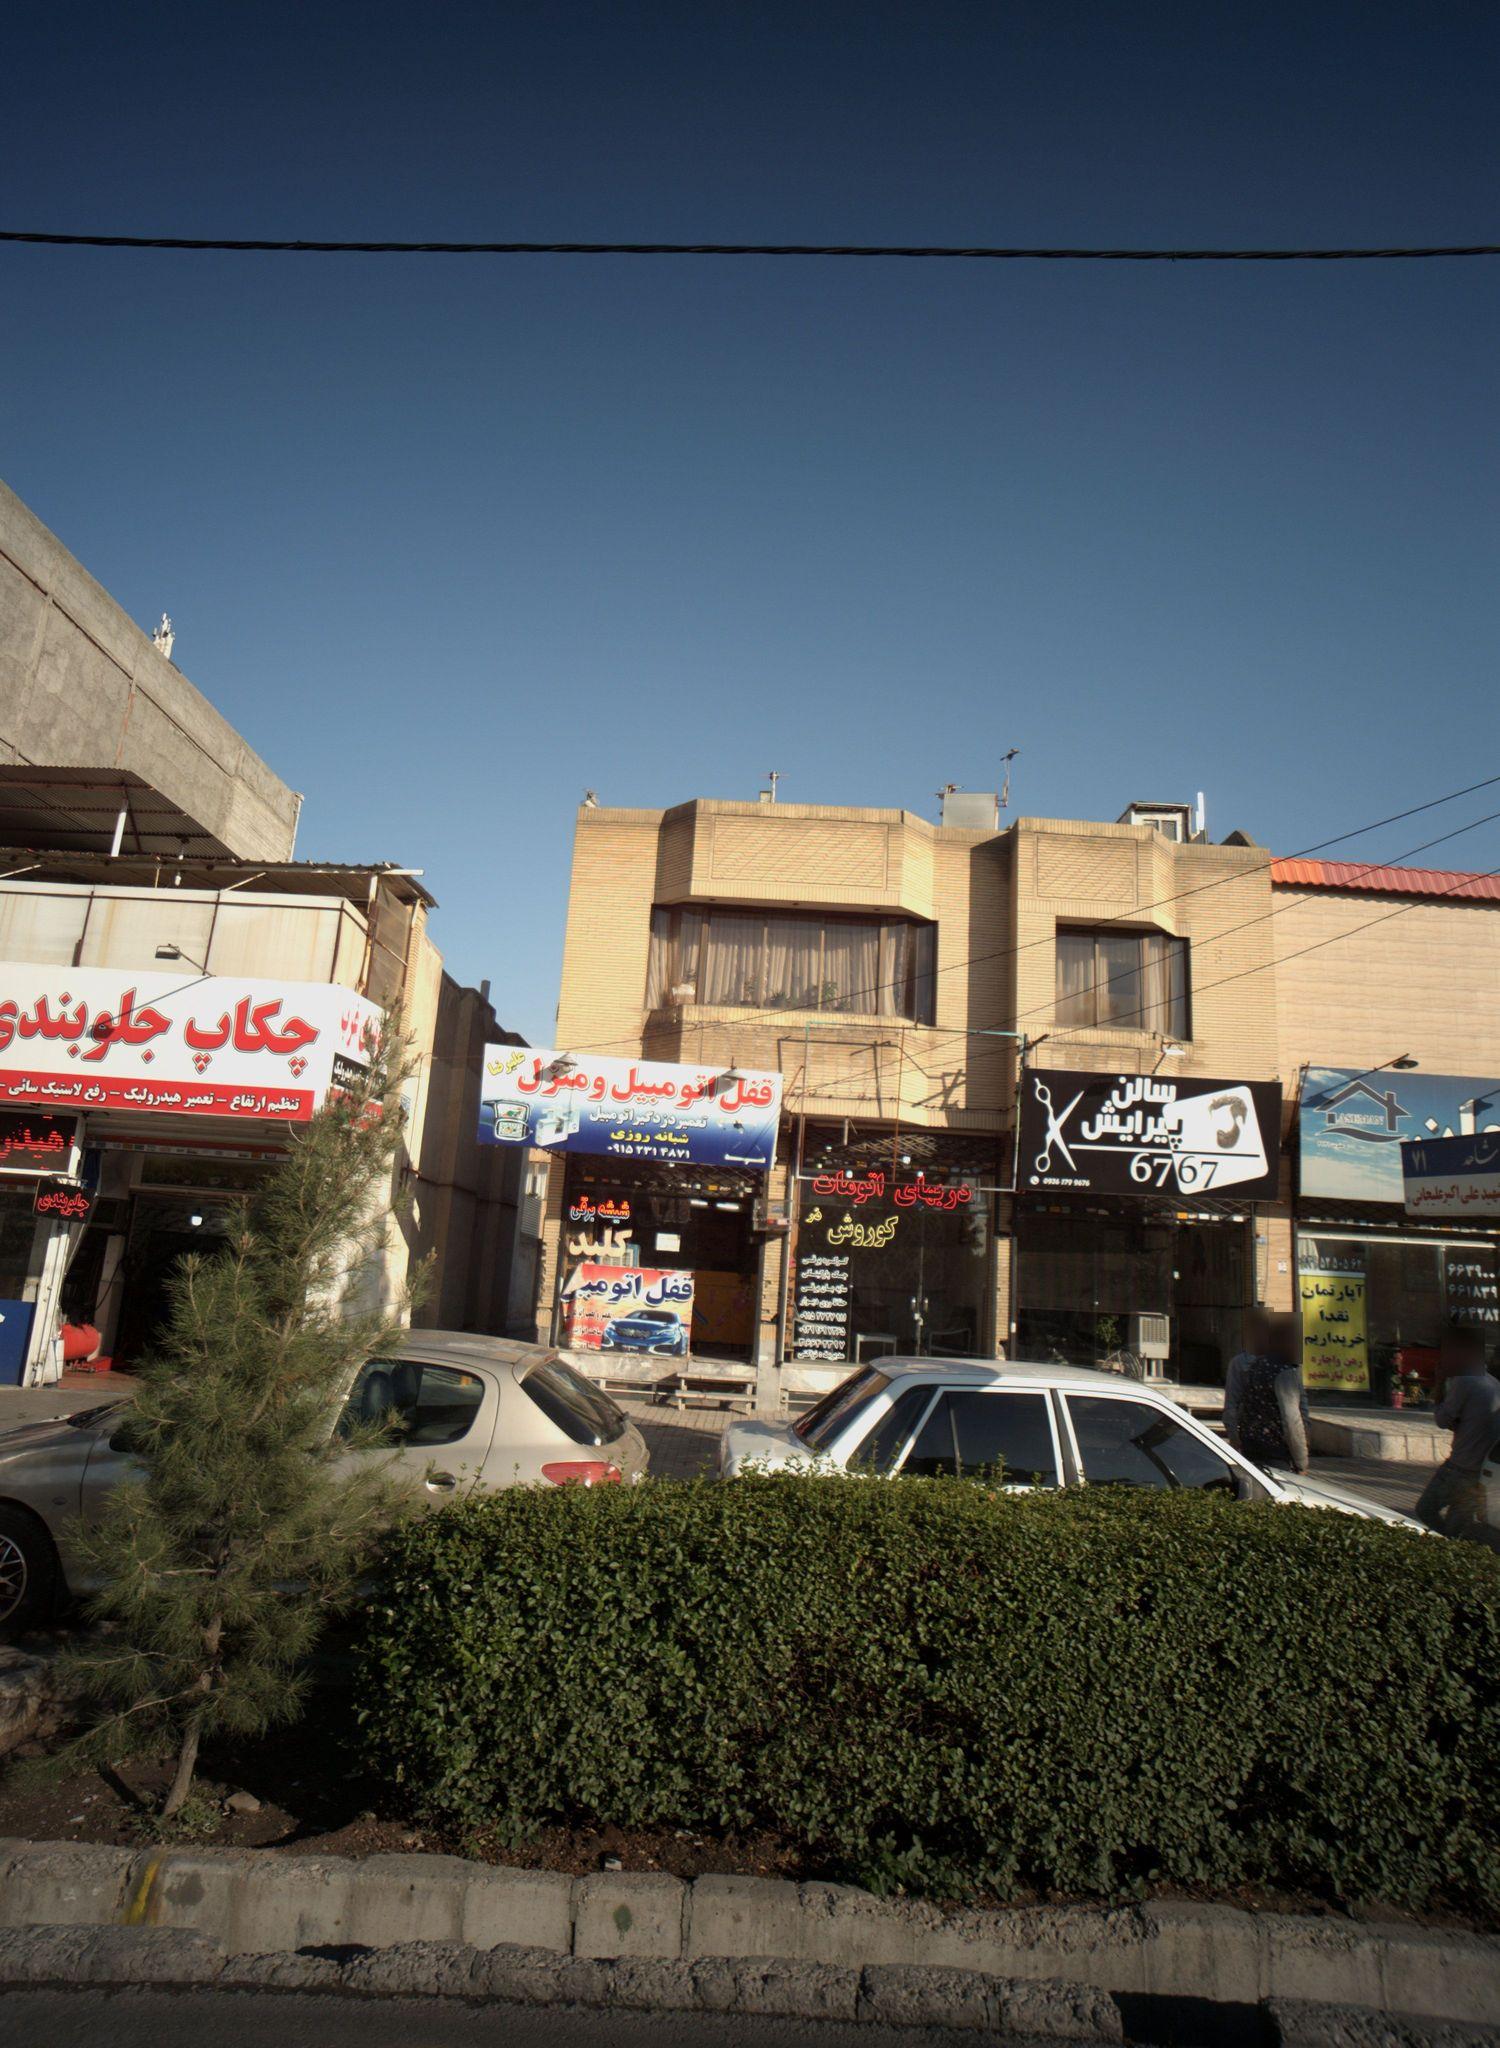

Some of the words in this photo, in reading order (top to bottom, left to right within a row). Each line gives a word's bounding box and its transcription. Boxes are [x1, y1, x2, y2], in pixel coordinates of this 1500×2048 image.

[184, 995, 320, 1078] چکاپ
[487, 1051, 525, 1076] علیرضا
[8, 1078, 38, 1096] سائی
[41, 1081, 82, 1096] لاستیک
[84, 1083, 106, 1101] رفع
[124, 1088, 181, 1106] هیدرولیک
[587, 1074, 606, 1101] و
[611, 1066, 717, 1110] اتومبیل
[719, 1076, 774, 1112] قفل
[1111, 1076, 1177, 1109] سالن
[184, 1092, 215, 1108] تعمیر
[229, 1095, 265, 1112] ارتفاع
[268, 1097, 300, 1112] تنظیم
[589, 1105, 634, 1125] اتومبیل
[633, 1110, 676, 1129] دزدگیر
[676, 1113, 709, 1129] تعمیر
[1081, 1100, 1183, 1149] پیرایش
[610, 1129, 650, 1143] روزی
[654, 1131, 689, 1145] شبانه
[607, 1144, 633, 1155] ۰۹۱۵
[1130, 1152, 1219, 1189] 6767
[1411, 1149, 1427, 1172] ۷۱
[1461, 1185, 1478, 1204] علی
[37, 1192, 90, 1218] جلوبندی
[570, 1196, 596, 1222] برقی
[598, 1199, 630, 1224] شیشه
[827, 1213, 899, 1247] کوروش
[569, 1227, 633, 1264] کلید
[646, 1275, 694, 1307] قفل
[1301, 1283, 1365, 1302] آپارتمان
[1304, 1331, 1366, 1348] خریداریم
